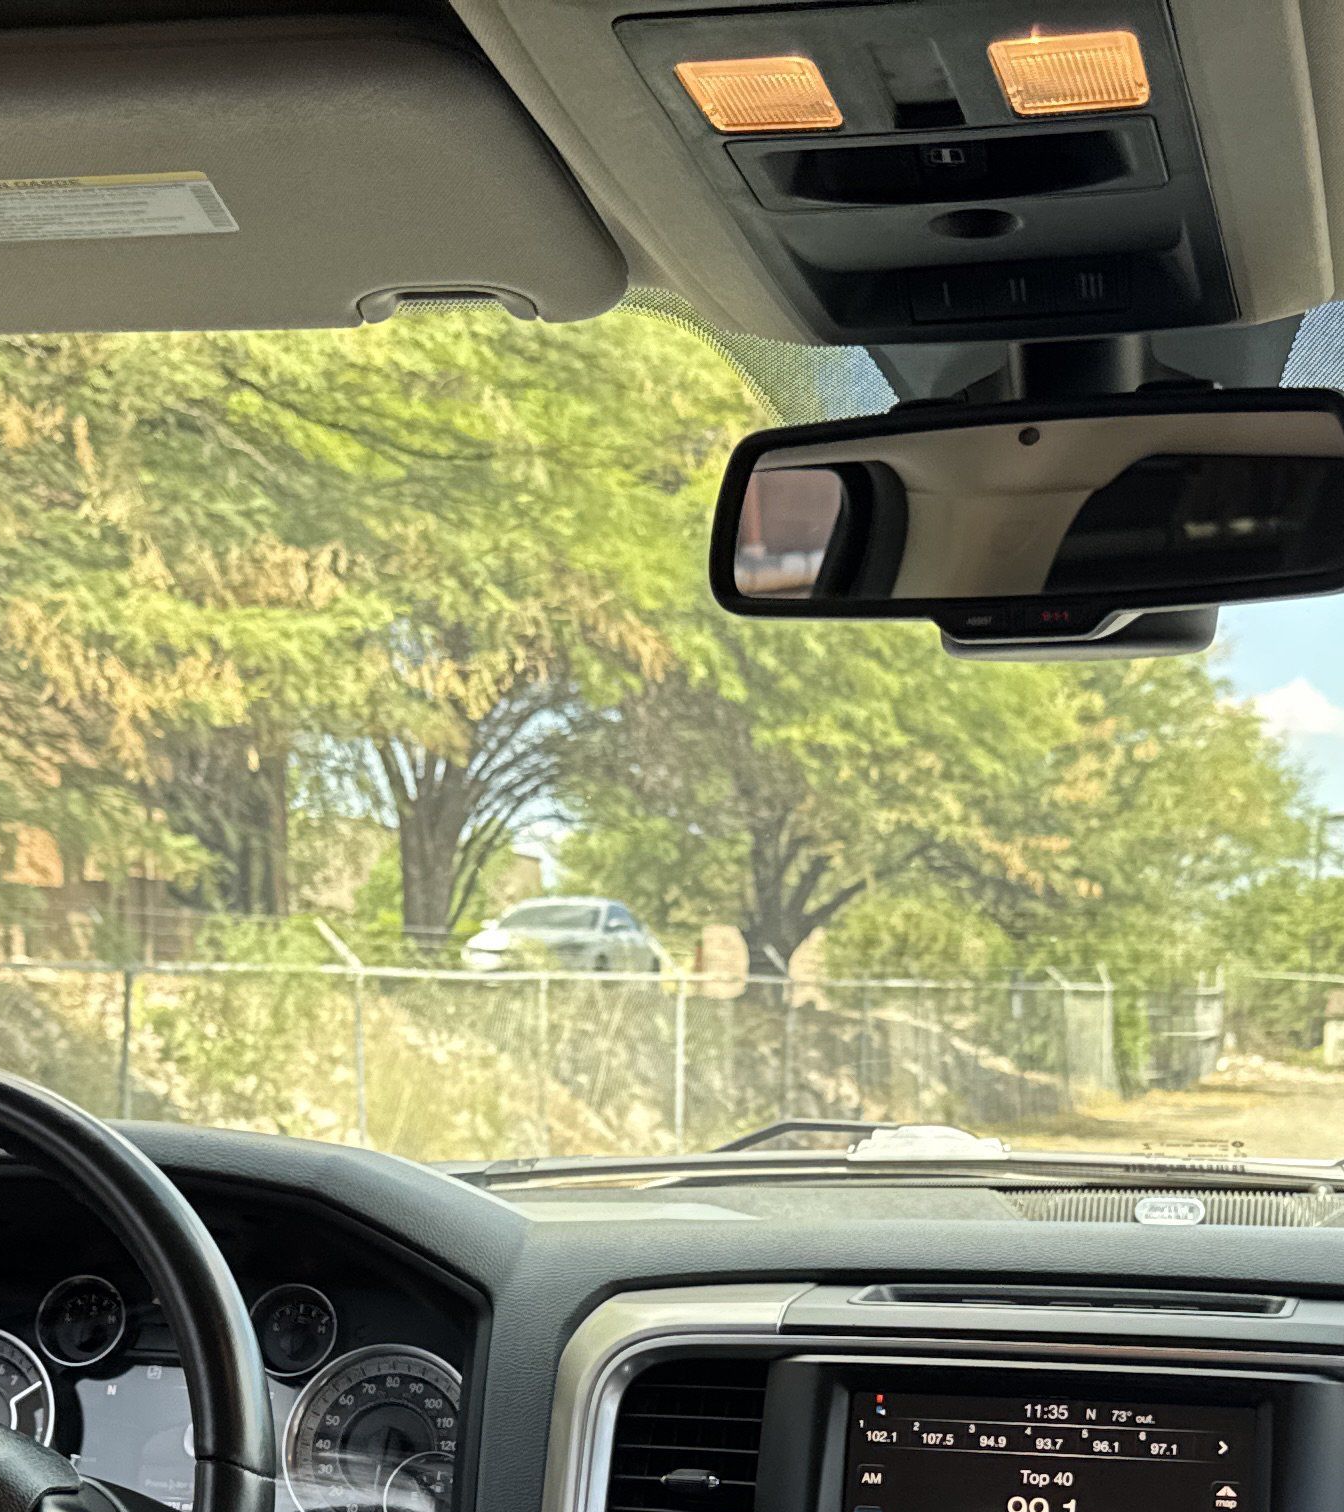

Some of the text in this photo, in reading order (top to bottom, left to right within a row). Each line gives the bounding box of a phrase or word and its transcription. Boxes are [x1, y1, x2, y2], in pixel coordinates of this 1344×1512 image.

[1024, 1403, 1069, 1420] 11:35
[1085, 1408, 1097, 1420] N
[859, 1419, 865, 1428] 1
[912, 1421, 920, 1431] 2
[968, 1424, 976, 1434] 3
[865, 1430, 897, 1443] 102.1
[1024, 1426, 1032, 1436] 4
[1081, 1429, 1089, 1438] 5
[1138, 1431, 1147, 1441] 6
[921, 1432, 954, 1446] 107.5
[979, 1435, 1007, 1448] 94.9
[1035, 1437, 1063, 1450] 93.7
[1092, 1440, 1119, 1453] 96.1
[1150, 1442, 1177, 1455] 97.1
[861, 1472, 882, 1485] AM
[1020, 1469, 1074, 1487] Top 40
